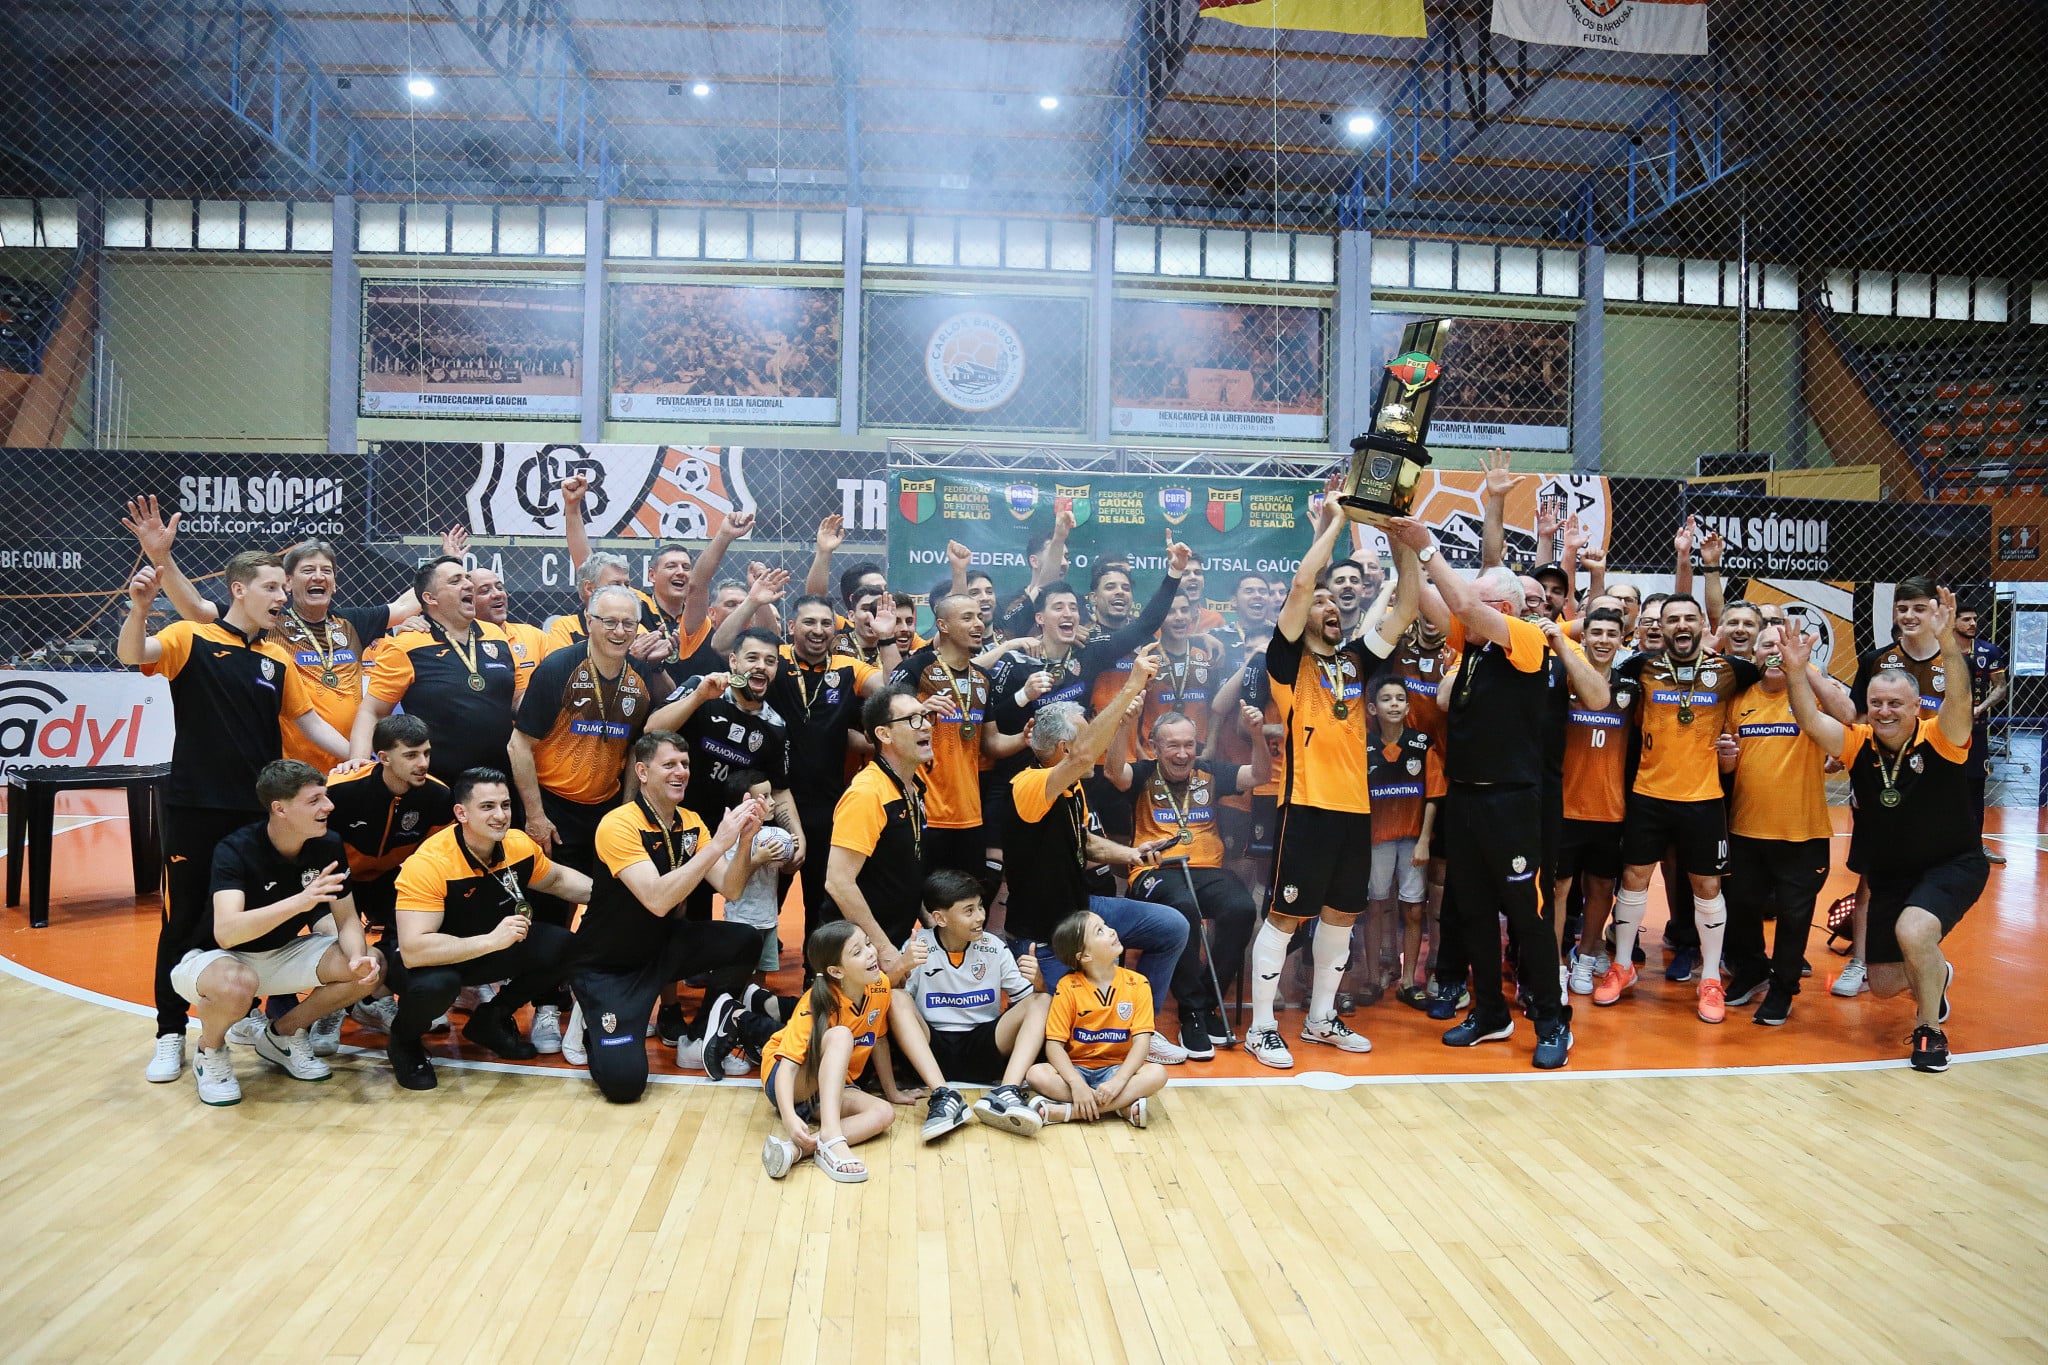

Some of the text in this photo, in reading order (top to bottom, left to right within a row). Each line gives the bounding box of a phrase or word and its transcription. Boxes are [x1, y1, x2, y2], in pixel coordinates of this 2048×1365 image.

[1596, 4, 1634, 32] BARBOSA
[1583, 33, 1619, 46] FUTSAL
[714, 397, 725, 407] DA
[727, 397, 743, 407] LIGA
[746, 398, 784, 408] NACIONAL
[1473, 425, 1507, 435] MUNDIAL
[179, 470, 343, 514] SEJA SÓCIO!
[903, 482, 933, 491] FGFS
[943, 493, 989, 503] GAÚCHA
[1057, 489, 1088, 497] FGFS
[1098, 490, 1144, 499] FEDERAÇÃO
[1165, 493, 1186, 503] CBFS
[1210, 492, 1240, 501] FGFS
[1098, 498, 1143, 508] GAÚCHA
[1249, 495, 1294, 503] FEDERAÇÃO
[1249, 502, 1293, 512] GAÚCHA
[957, 510, 992, 520] SALÃO
[1112, 514, 1146, 525] SALÃO
[1263, 518, 1295, 528] SALÃO
[1747, 511, 1829, 553] SÓCIO!
[1075, 555, 1088, 568] O
[1201, 558, 1253, 571] UTSAL
[1256, 557, 1302, 573] GAÚC
[1880, 661, 1905, 669] CRESOL
[620, 685, 641, 694] CRESOL
[1036, 686, 1083, 707] TRAMONTINA
[1572, 713, 1621, 725] TRAMONTINA
[1741, 726, 1795, 735] TRAMONTINA
[1304, 726, 1314, 748] 7
[1591, 728, 1606, 748] 10
[703, 740, 752, 765] TRAMONTINA
[710, 761, 729, 782] 30
[1370, 786, 1420, 797] TRAMONTINA
[1717, 839, 1728, 859] 10
[929, 993, 991, 1006] TRAMONTINA
[1077, 1030, 1127, 1041] TRAMONTINA
